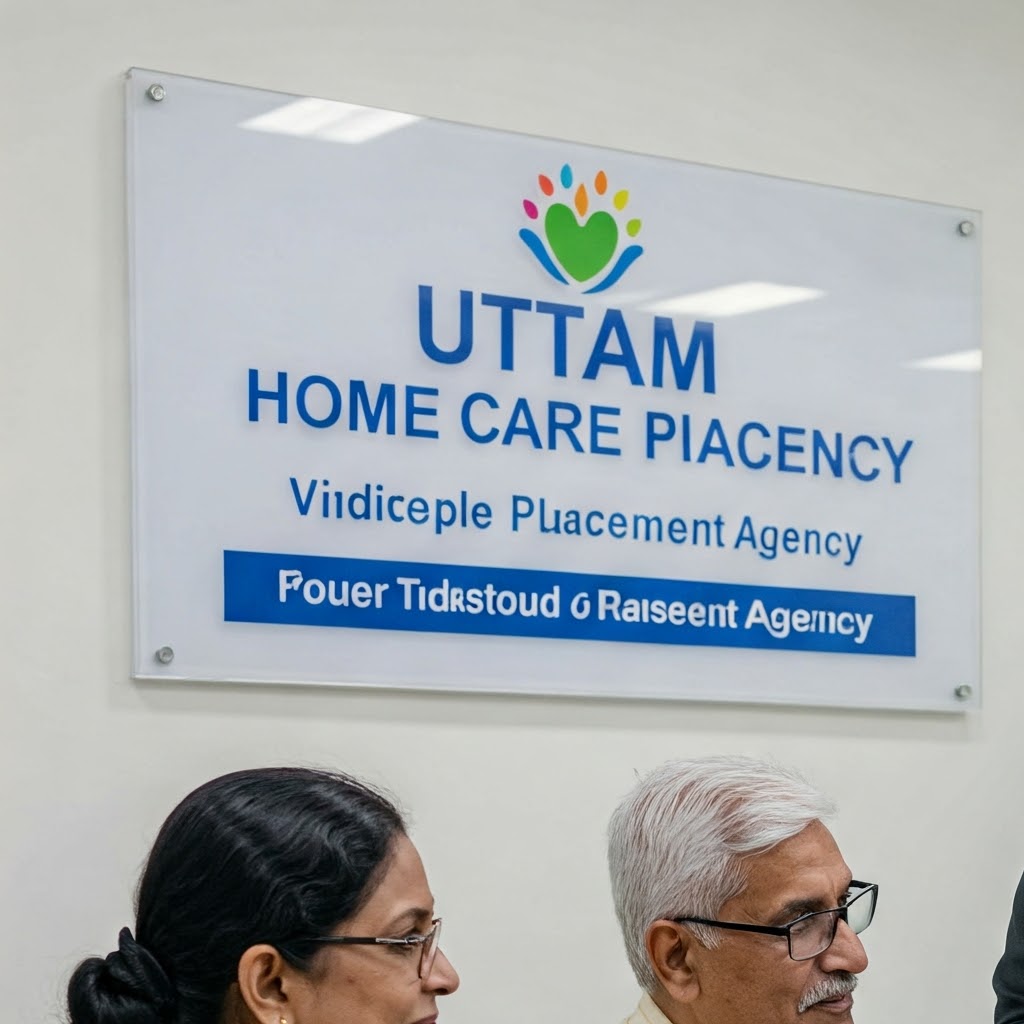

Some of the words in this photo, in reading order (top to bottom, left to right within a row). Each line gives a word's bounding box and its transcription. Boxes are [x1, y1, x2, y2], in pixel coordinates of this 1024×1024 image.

[417, 284, 718, 396] UTTAM
[246, 367, 441, 442] HOME
[459, 390, 623, 459] CARE
[733, 515, 864, 568] Agency
